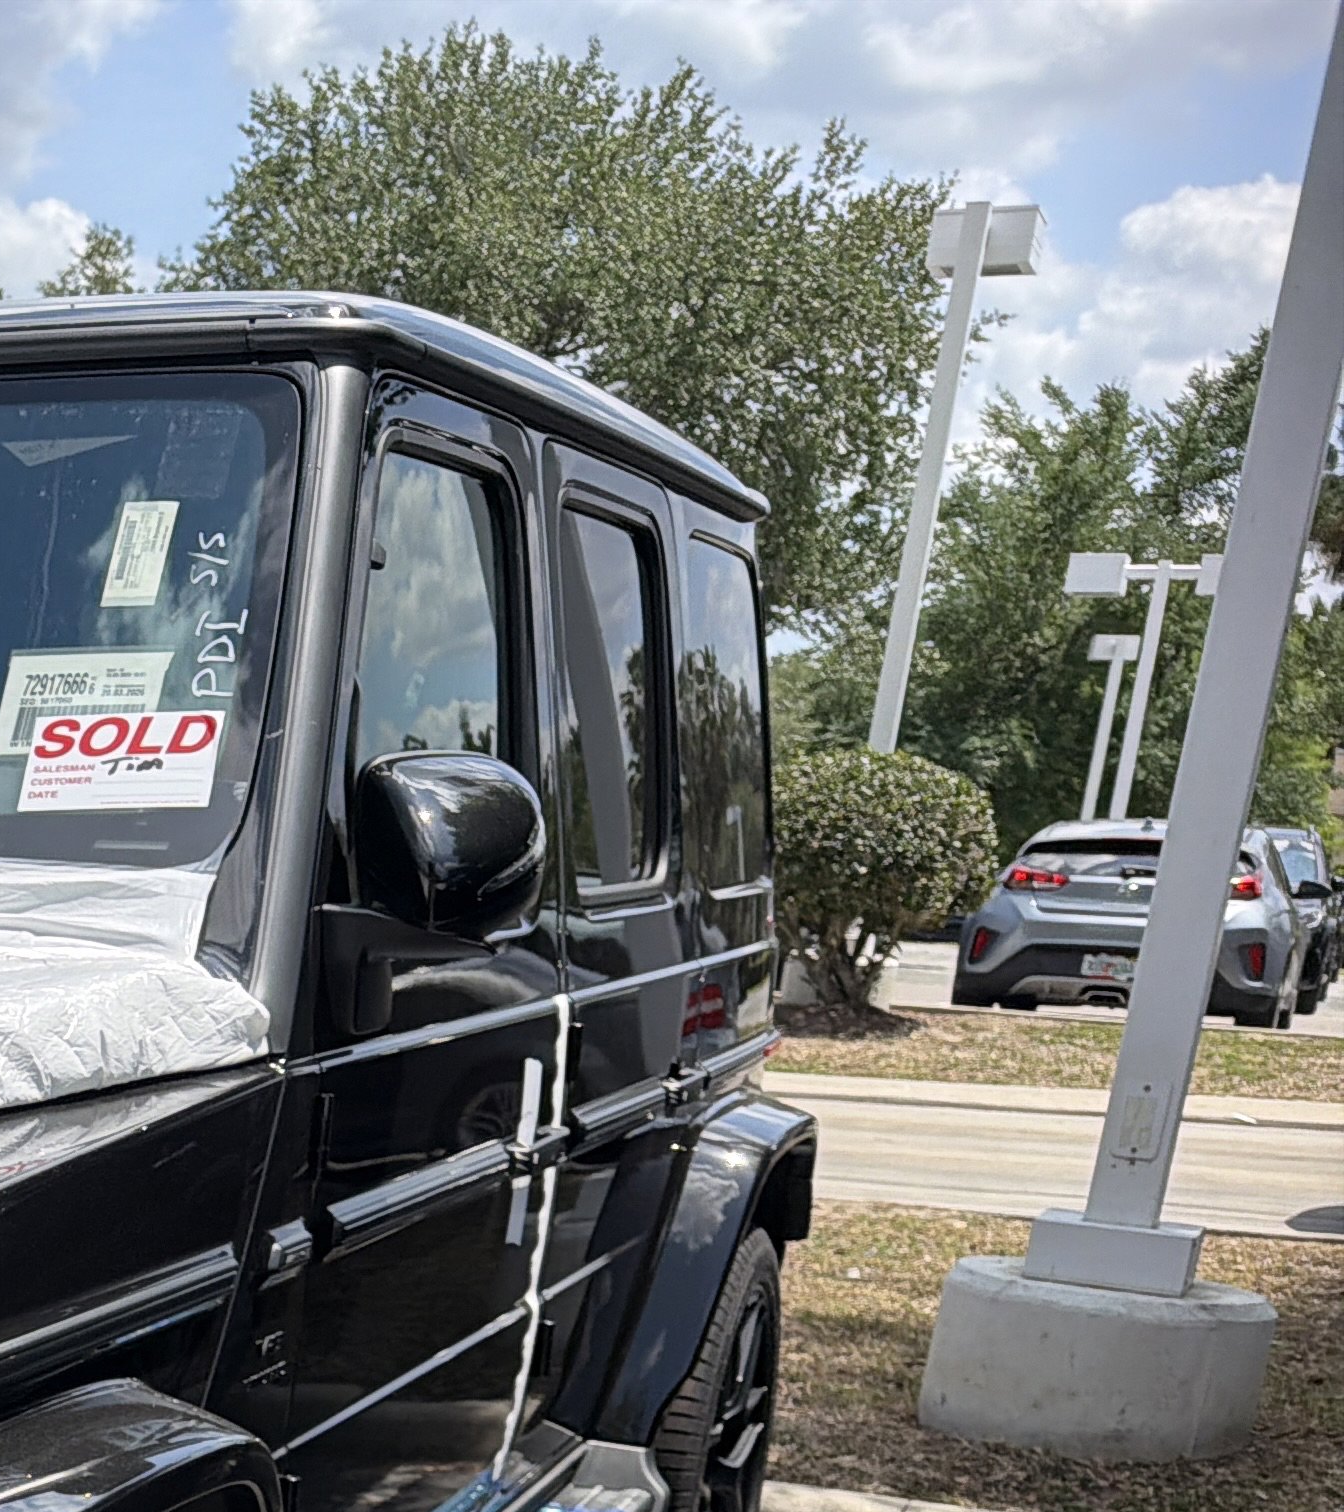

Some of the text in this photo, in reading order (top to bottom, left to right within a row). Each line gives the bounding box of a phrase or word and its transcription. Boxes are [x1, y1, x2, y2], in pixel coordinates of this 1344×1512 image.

[192, 608, 249, 697] PDI
[34, 715, 217, 758] SOLD
[33, 763, 95, 774] SALESMAN
[30, 776, 92, 787] CUSTOMER
[27, 790, 58, 800] DATE
